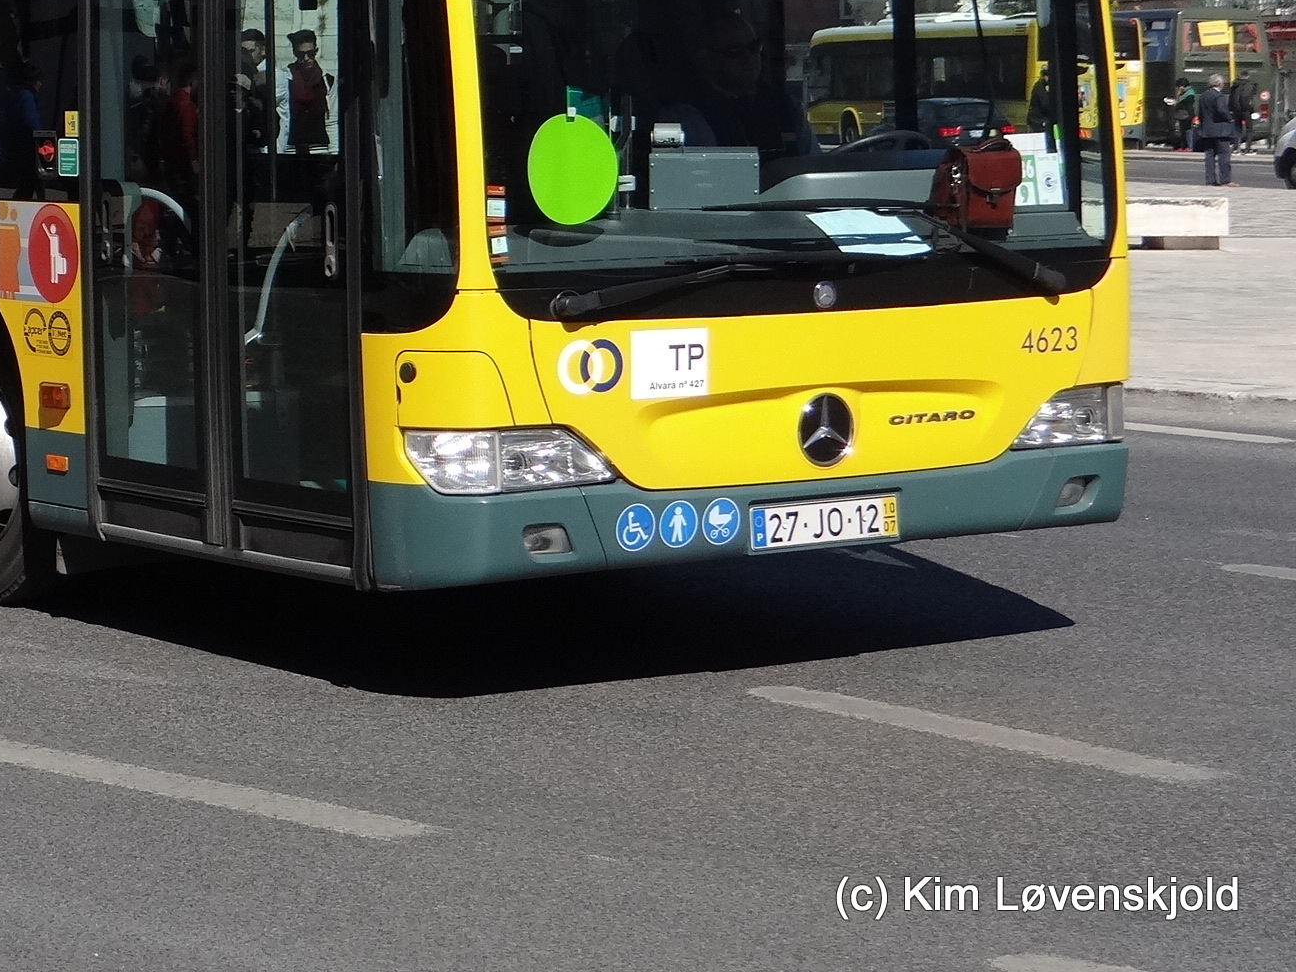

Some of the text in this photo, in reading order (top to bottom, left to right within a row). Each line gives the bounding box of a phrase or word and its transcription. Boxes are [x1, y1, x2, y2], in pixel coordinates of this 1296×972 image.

[1020, 325, 1078, 354] 4623
[668, 343, 705, 371] TP
[649, 380, 677, 390] Alvará
[688, 379, 705, 388] 427
[888, 408, 976, 426] CITARO
[883, 501, 895, 514] 10
[883, 520, 896, 532] 07
[756, 533, 764, 542] P
